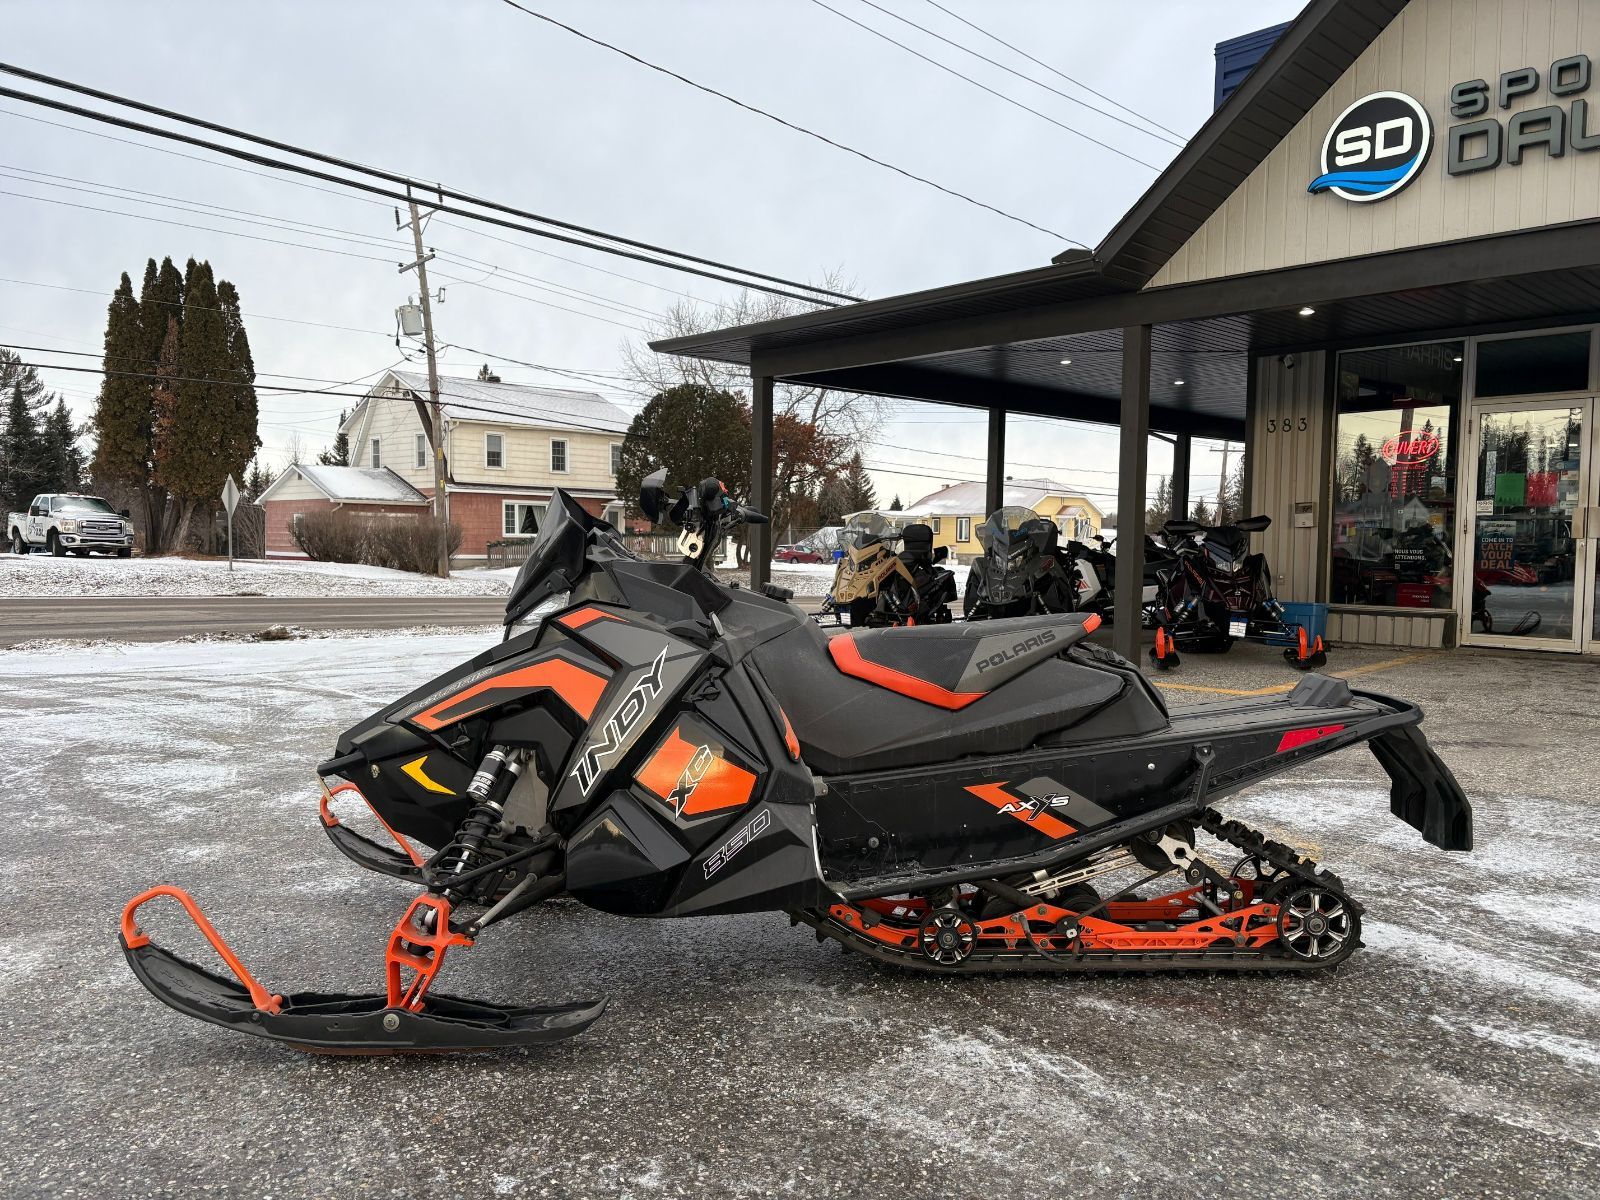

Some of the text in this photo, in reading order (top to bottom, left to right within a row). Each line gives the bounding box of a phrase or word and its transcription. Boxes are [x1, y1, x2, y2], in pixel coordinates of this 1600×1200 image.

[1335, 116, 1413, 167] SD
[1267, 417, 1307, 433] 383
[1386, 437, 1437, 456] OUVERT
[1481, 543, 1513, 551] CATCH
[1481, 550, 1512, 560] YOUR
[1480, 559, 1513, 570] DEAL
[975, 629, 1057, 674] POLARIS
[569, 643, 670, 798] INDY
[666, 743, 714, 821] XC
[996, 793, 1070, 821] AXYS
[702, 808, 771, 880] 850
